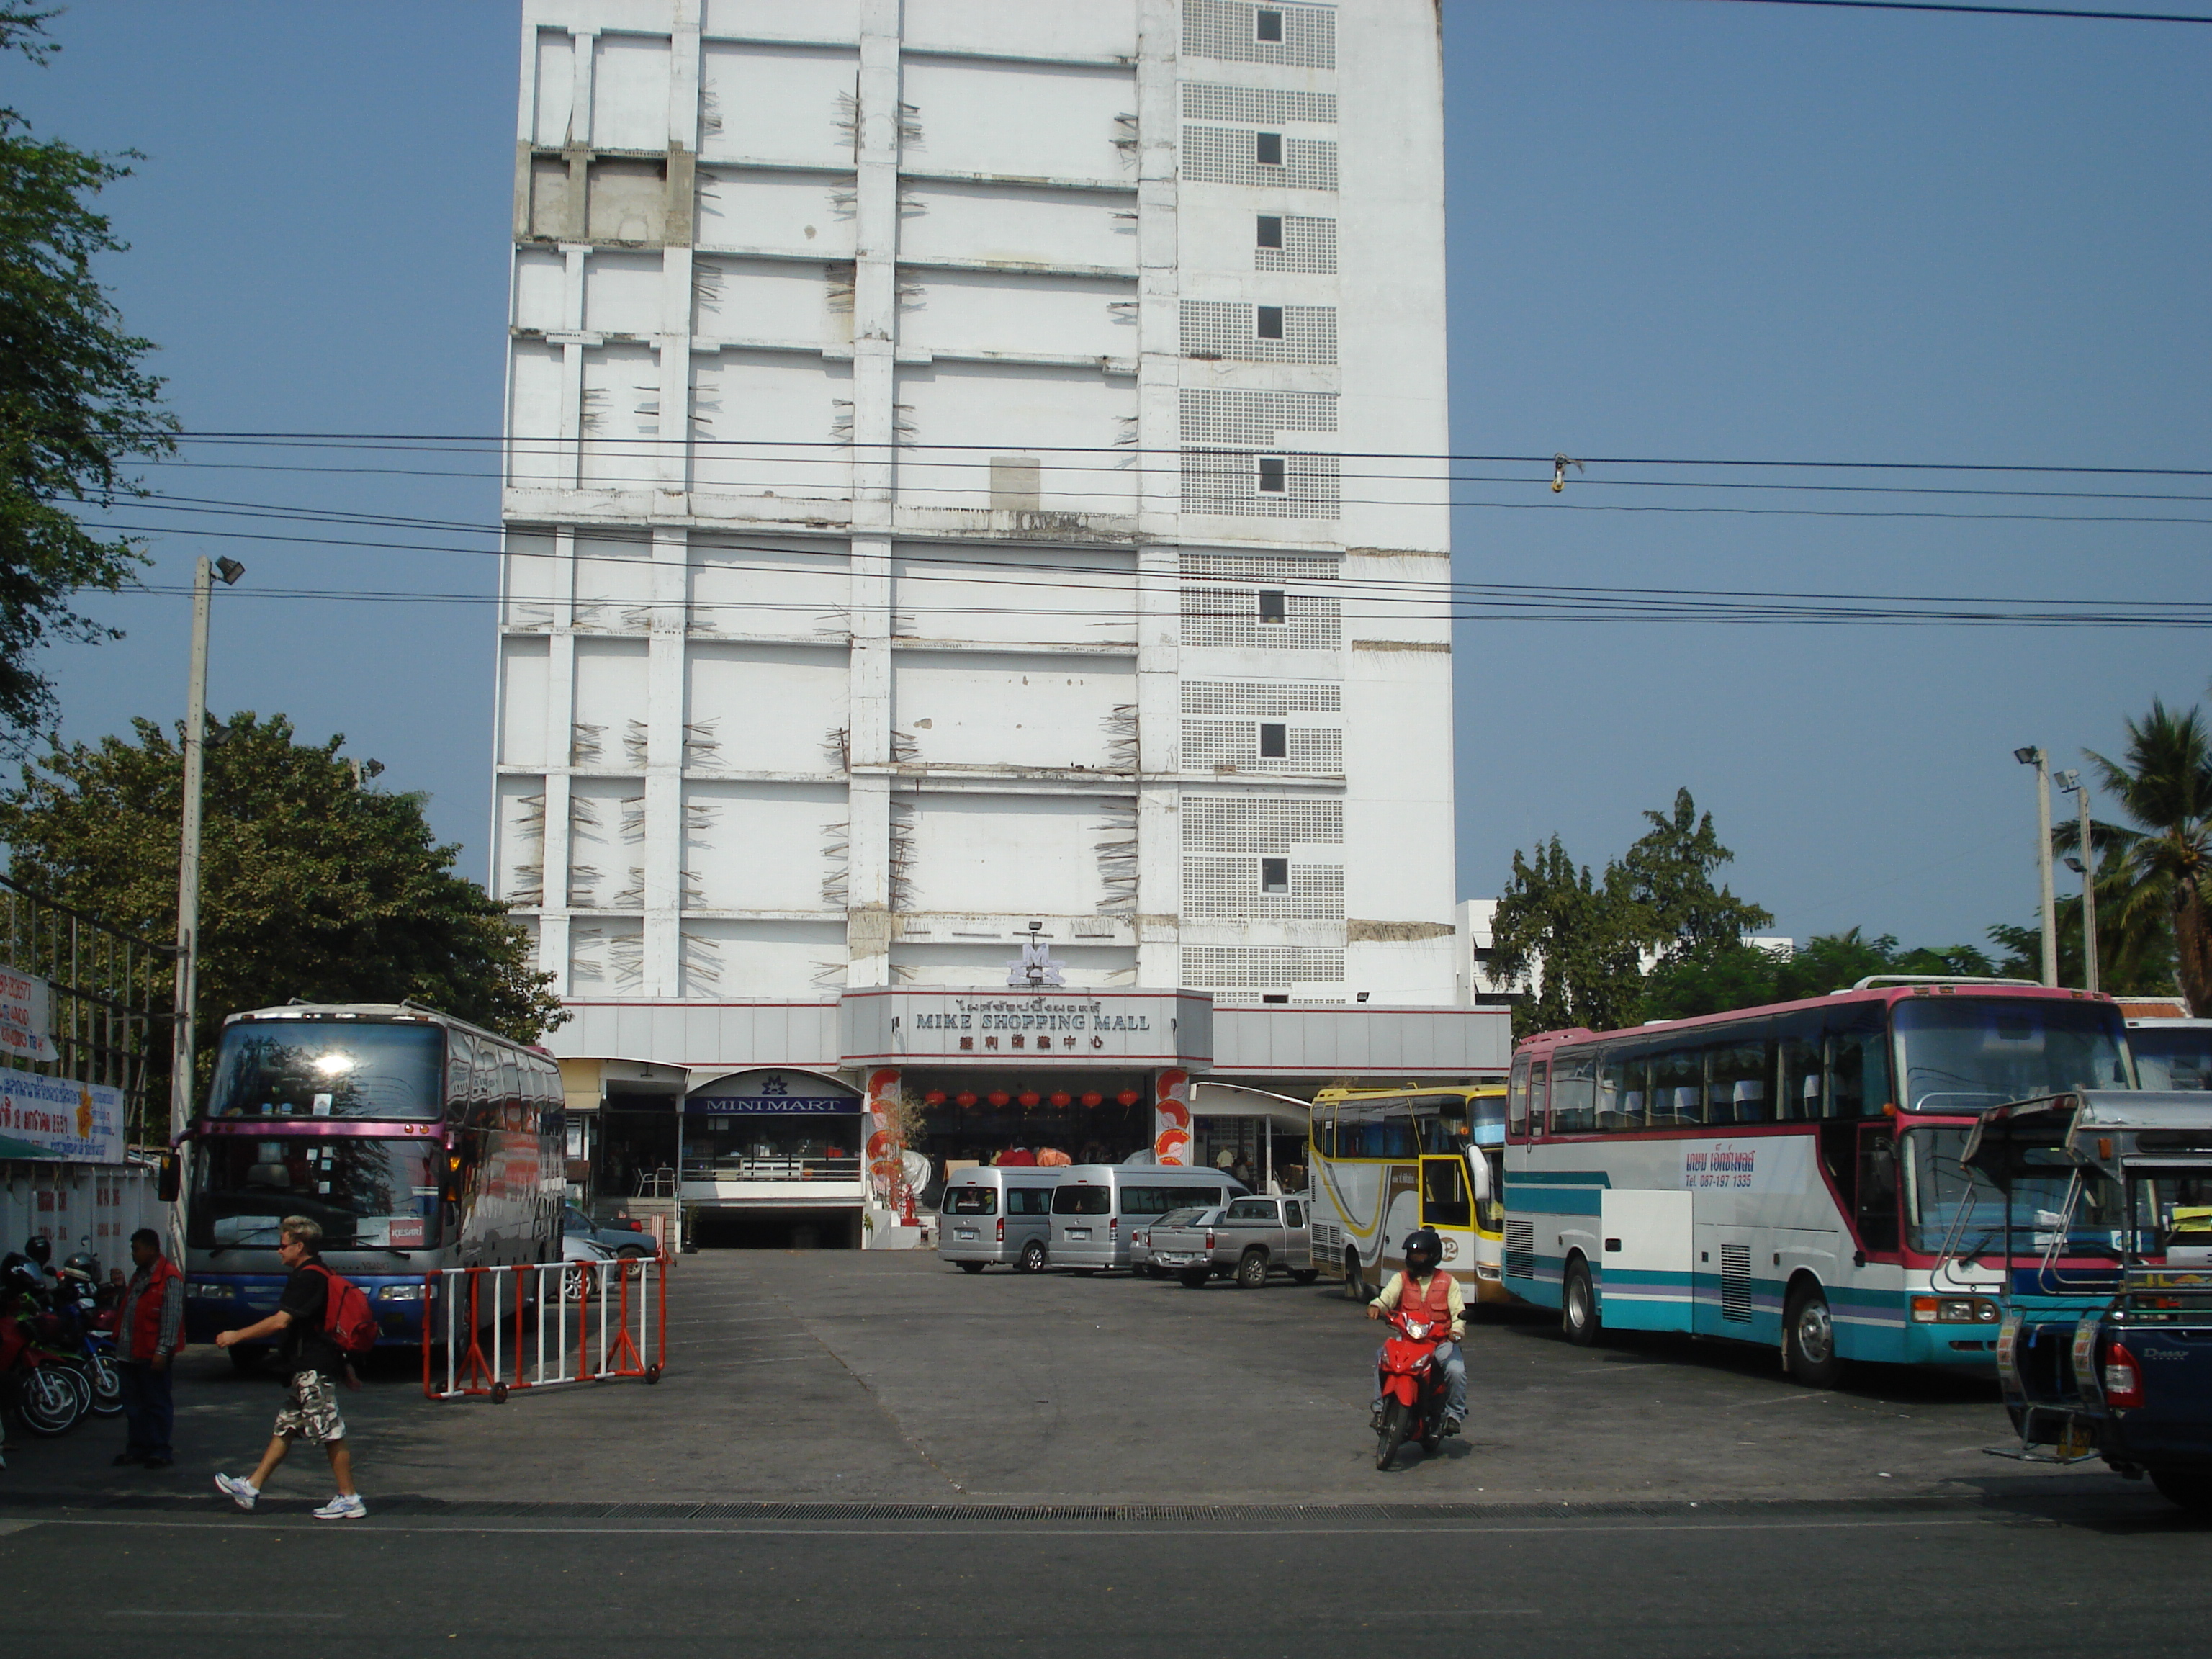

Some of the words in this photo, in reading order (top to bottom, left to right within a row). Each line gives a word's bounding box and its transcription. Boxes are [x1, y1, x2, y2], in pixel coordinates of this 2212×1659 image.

[916, 1014, 972, 1030] MIKE
[982, 1015, 1086, 1030] SHOPPING
[1094, 1015, 1150, 1030] MALL
[707, 1100, 763, 1110] MINI
[766, 1100, 840, 1110] MART
[1686, 1174, 1696, 1187] Tel.
[1700, 1174, 1730, 1187] 087-197
[1732, 1174, 1752, 1187] 1335
